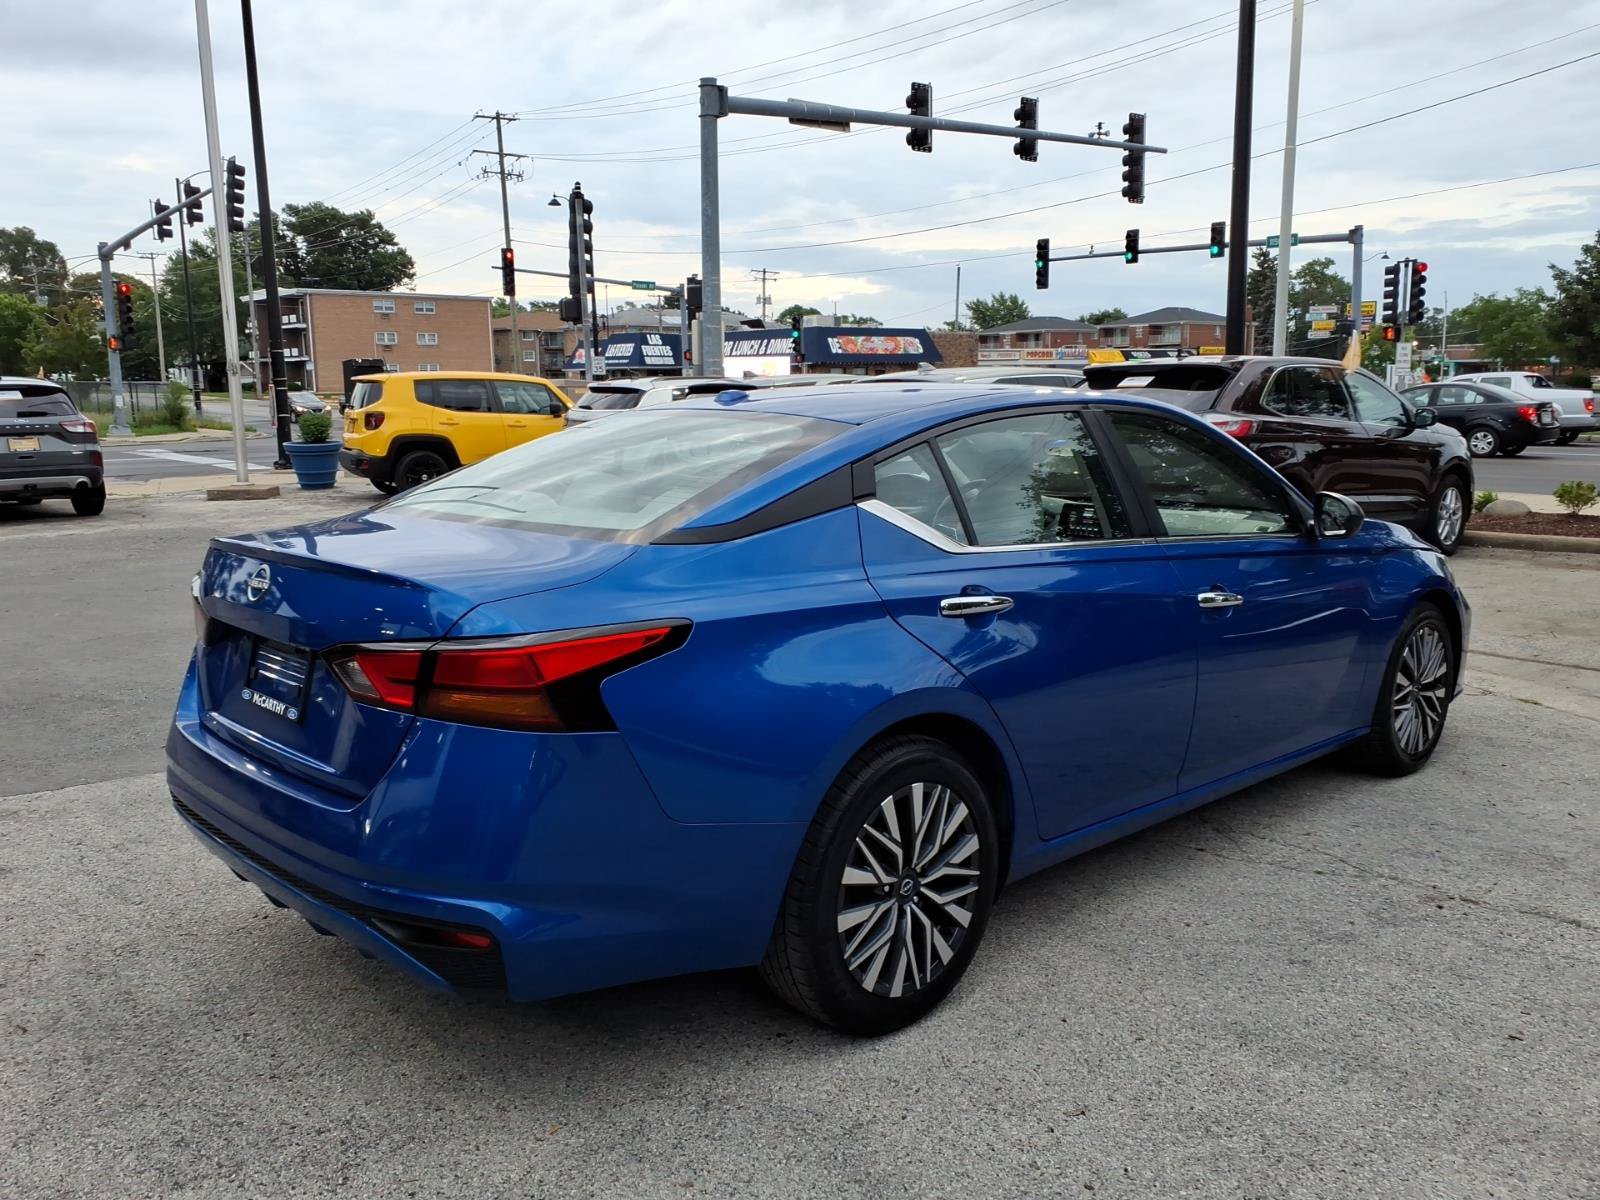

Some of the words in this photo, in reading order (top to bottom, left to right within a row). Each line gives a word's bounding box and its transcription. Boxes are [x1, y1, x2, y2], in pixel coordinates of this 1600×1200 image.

[646, 334, 662, 345] LAS
[732, 339, 761, 356] LUNCH
[759, 339, 768, 355] &
[766, 337, 795, 354] DINNE
[641, 345, 673, 356] FUENTES
[252, 692, 286, 716] McCARTHY
